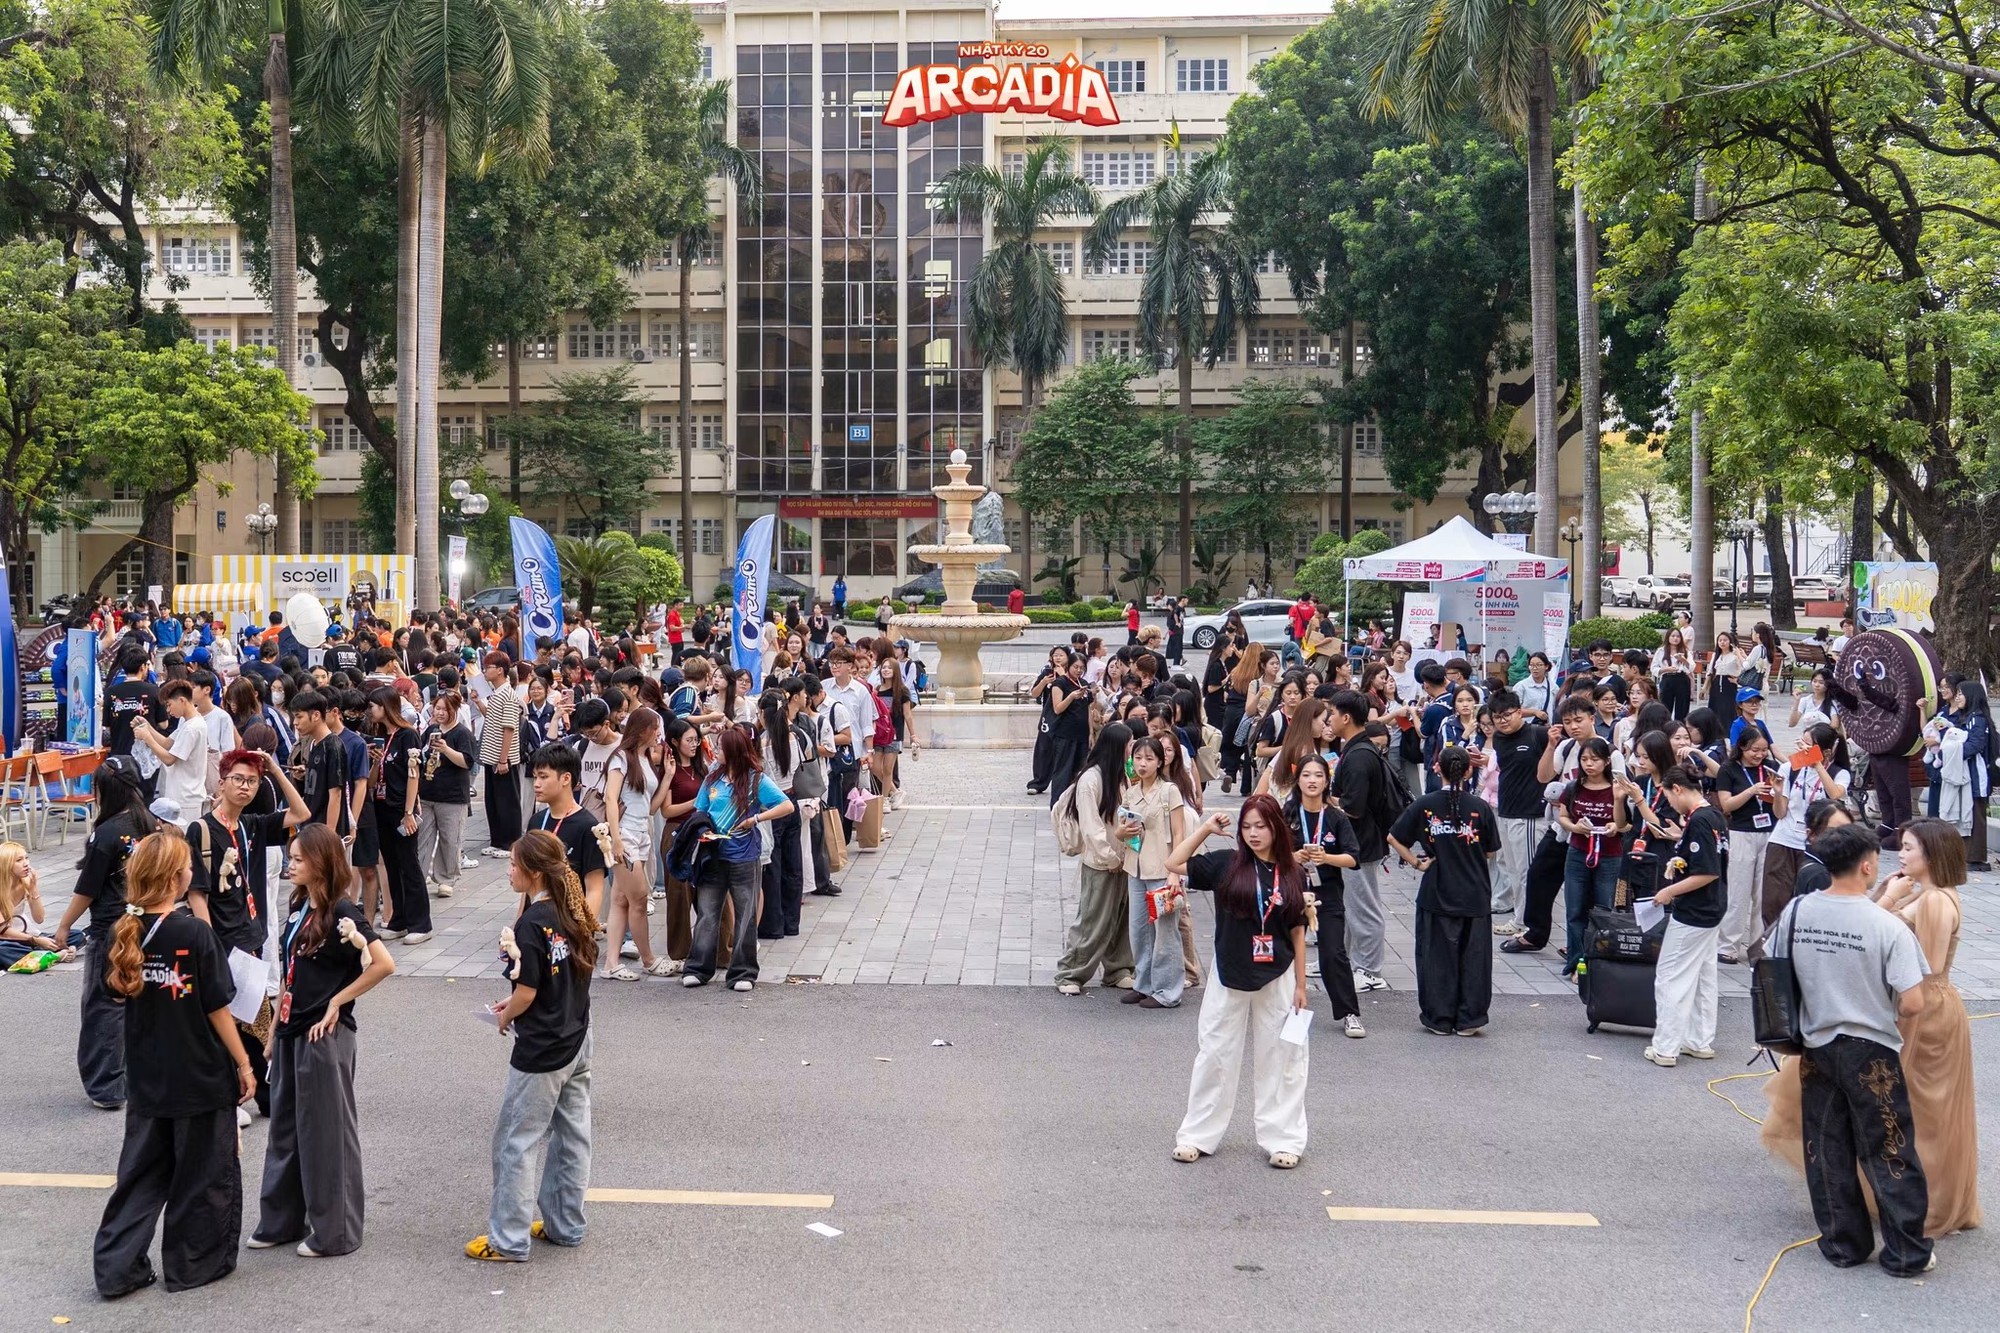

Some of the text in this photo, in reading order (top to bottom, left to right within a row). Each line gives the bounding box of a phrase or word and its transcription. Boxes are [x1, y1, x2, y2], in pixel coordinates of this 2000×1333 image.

[853, 428, 866, 438] B1
[1476, 587, 1512, 598] 5000
[1543, 609, 1564, 618] 5000
[1803, 926, 1822, 934] NẮNG
